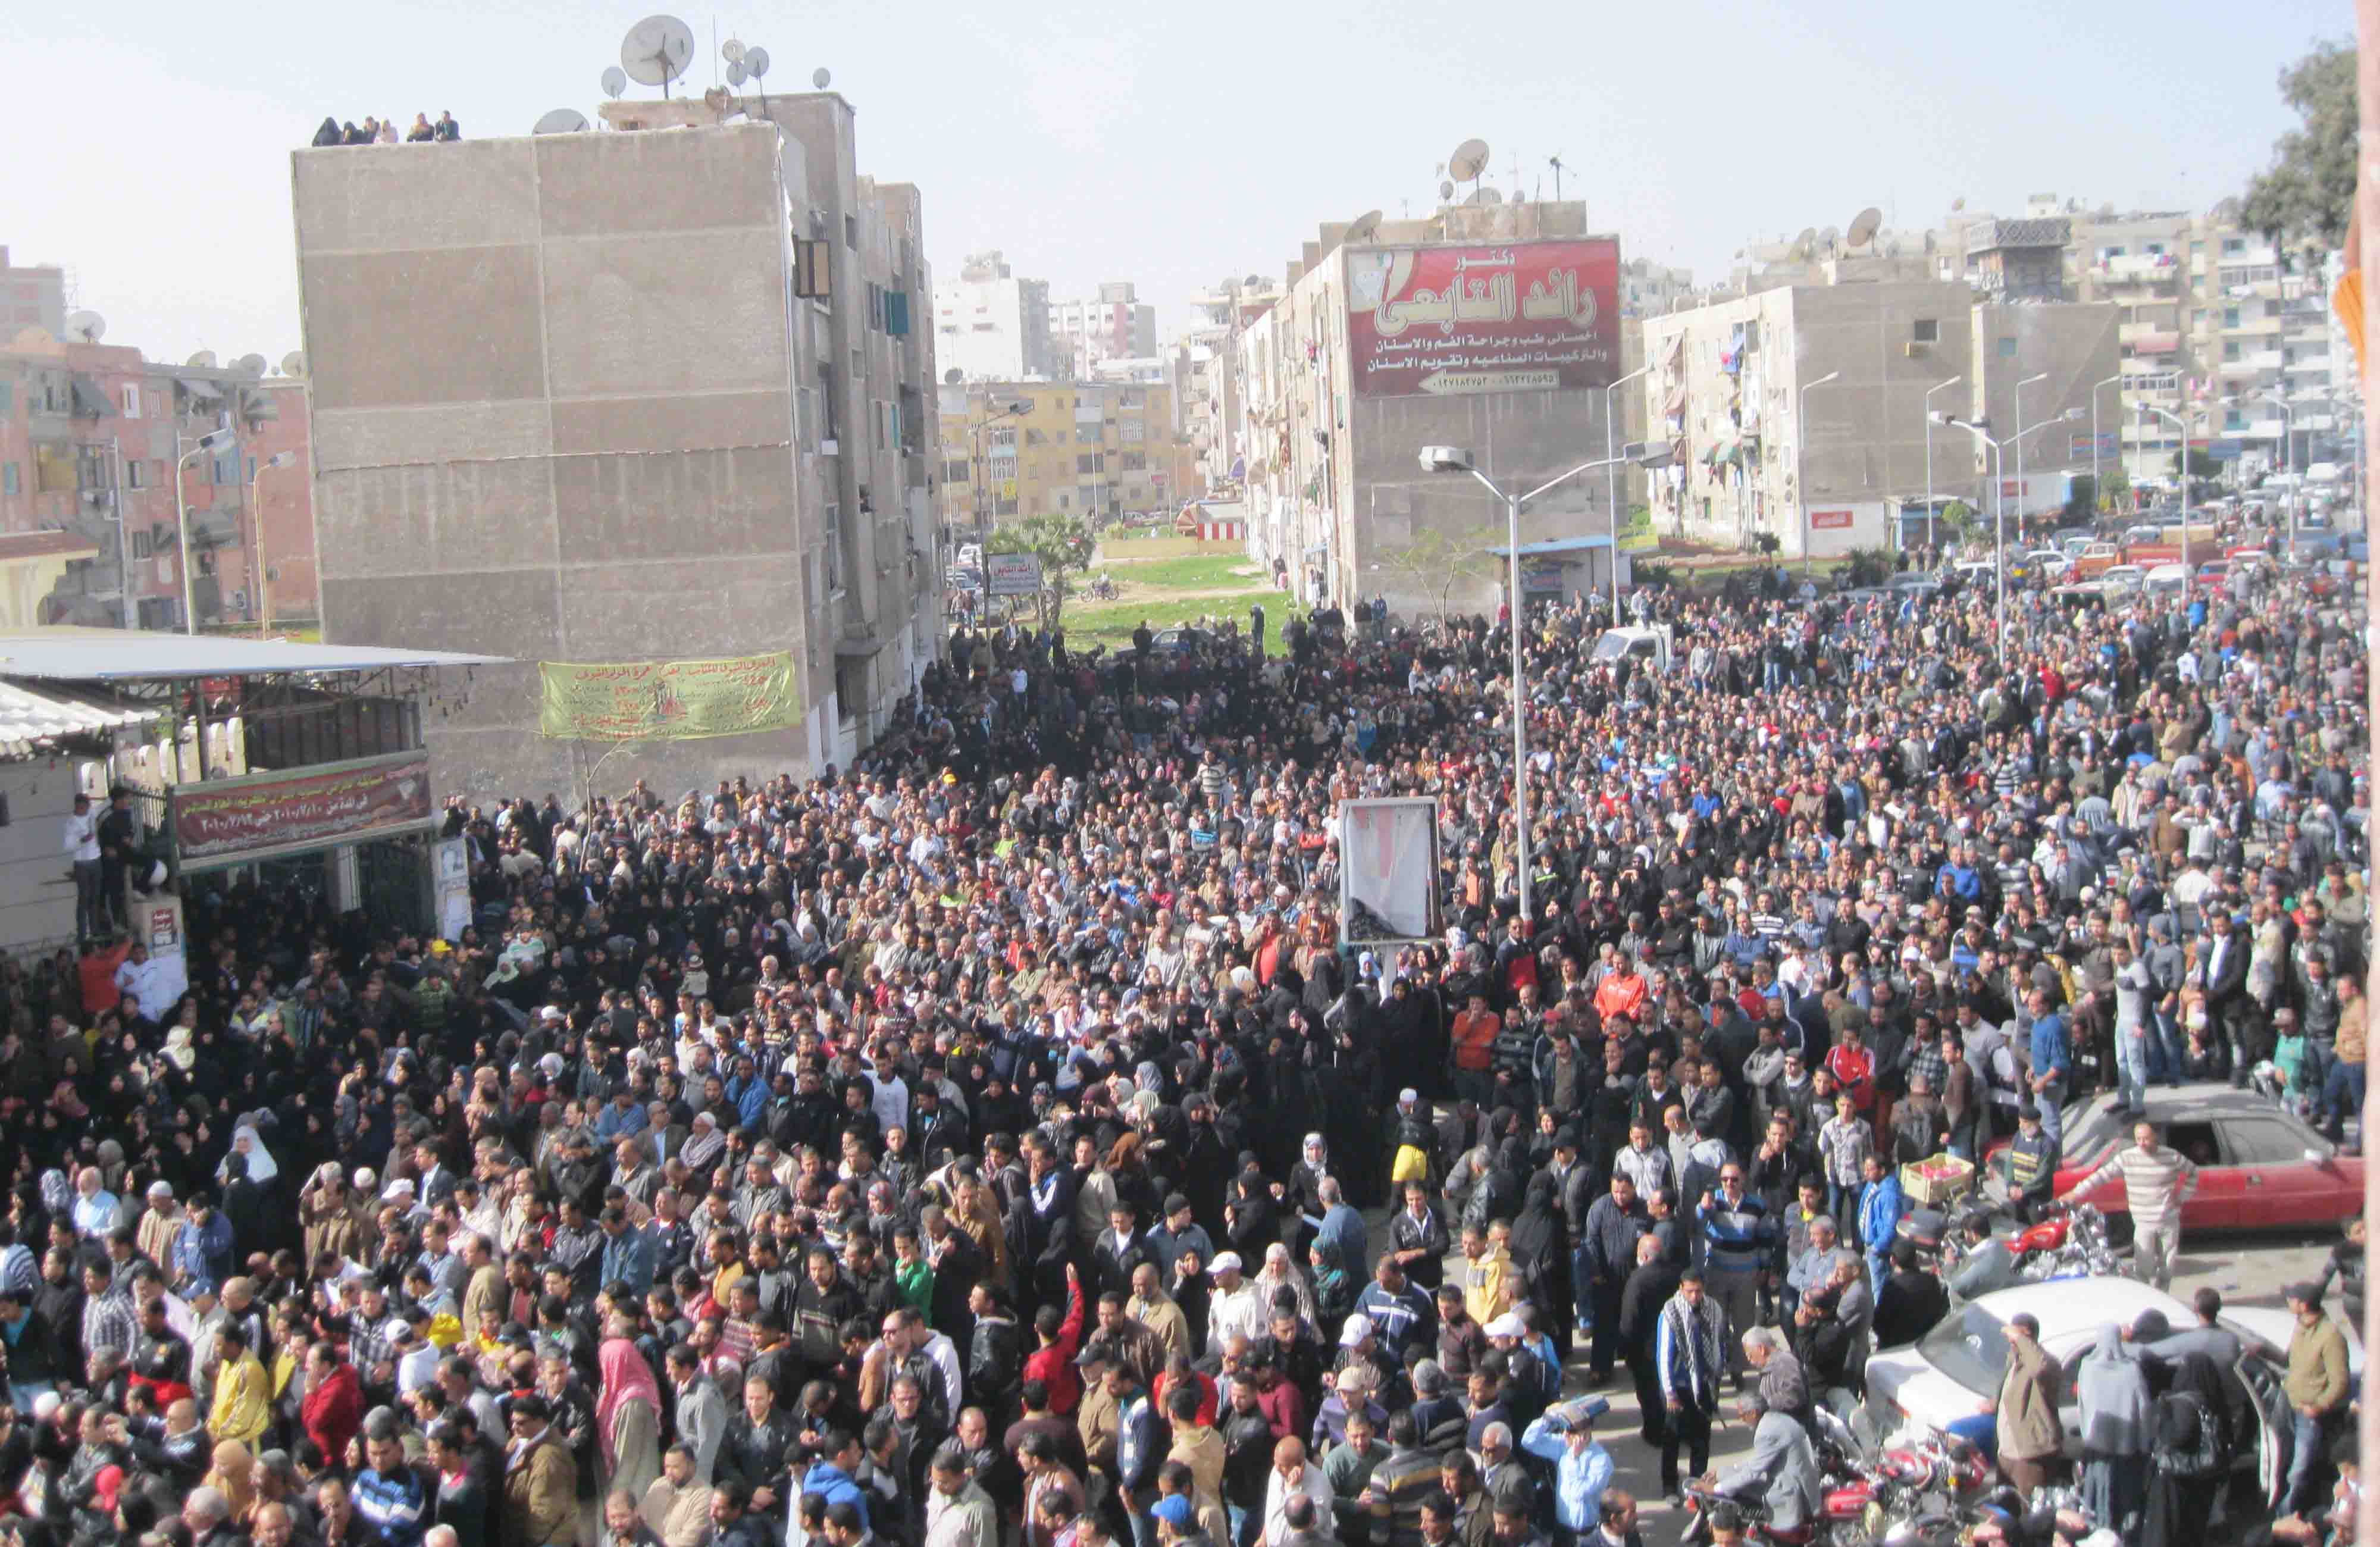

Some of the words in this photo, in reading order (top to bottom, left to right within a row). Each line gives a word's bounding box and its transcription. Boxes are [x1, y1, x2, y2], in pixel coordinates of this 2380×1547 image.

[1454, 249, 1516, 271] دكتور
[1523, 267, 1597, 328] رائد
[1435, 334, 1465, 350] الفم
